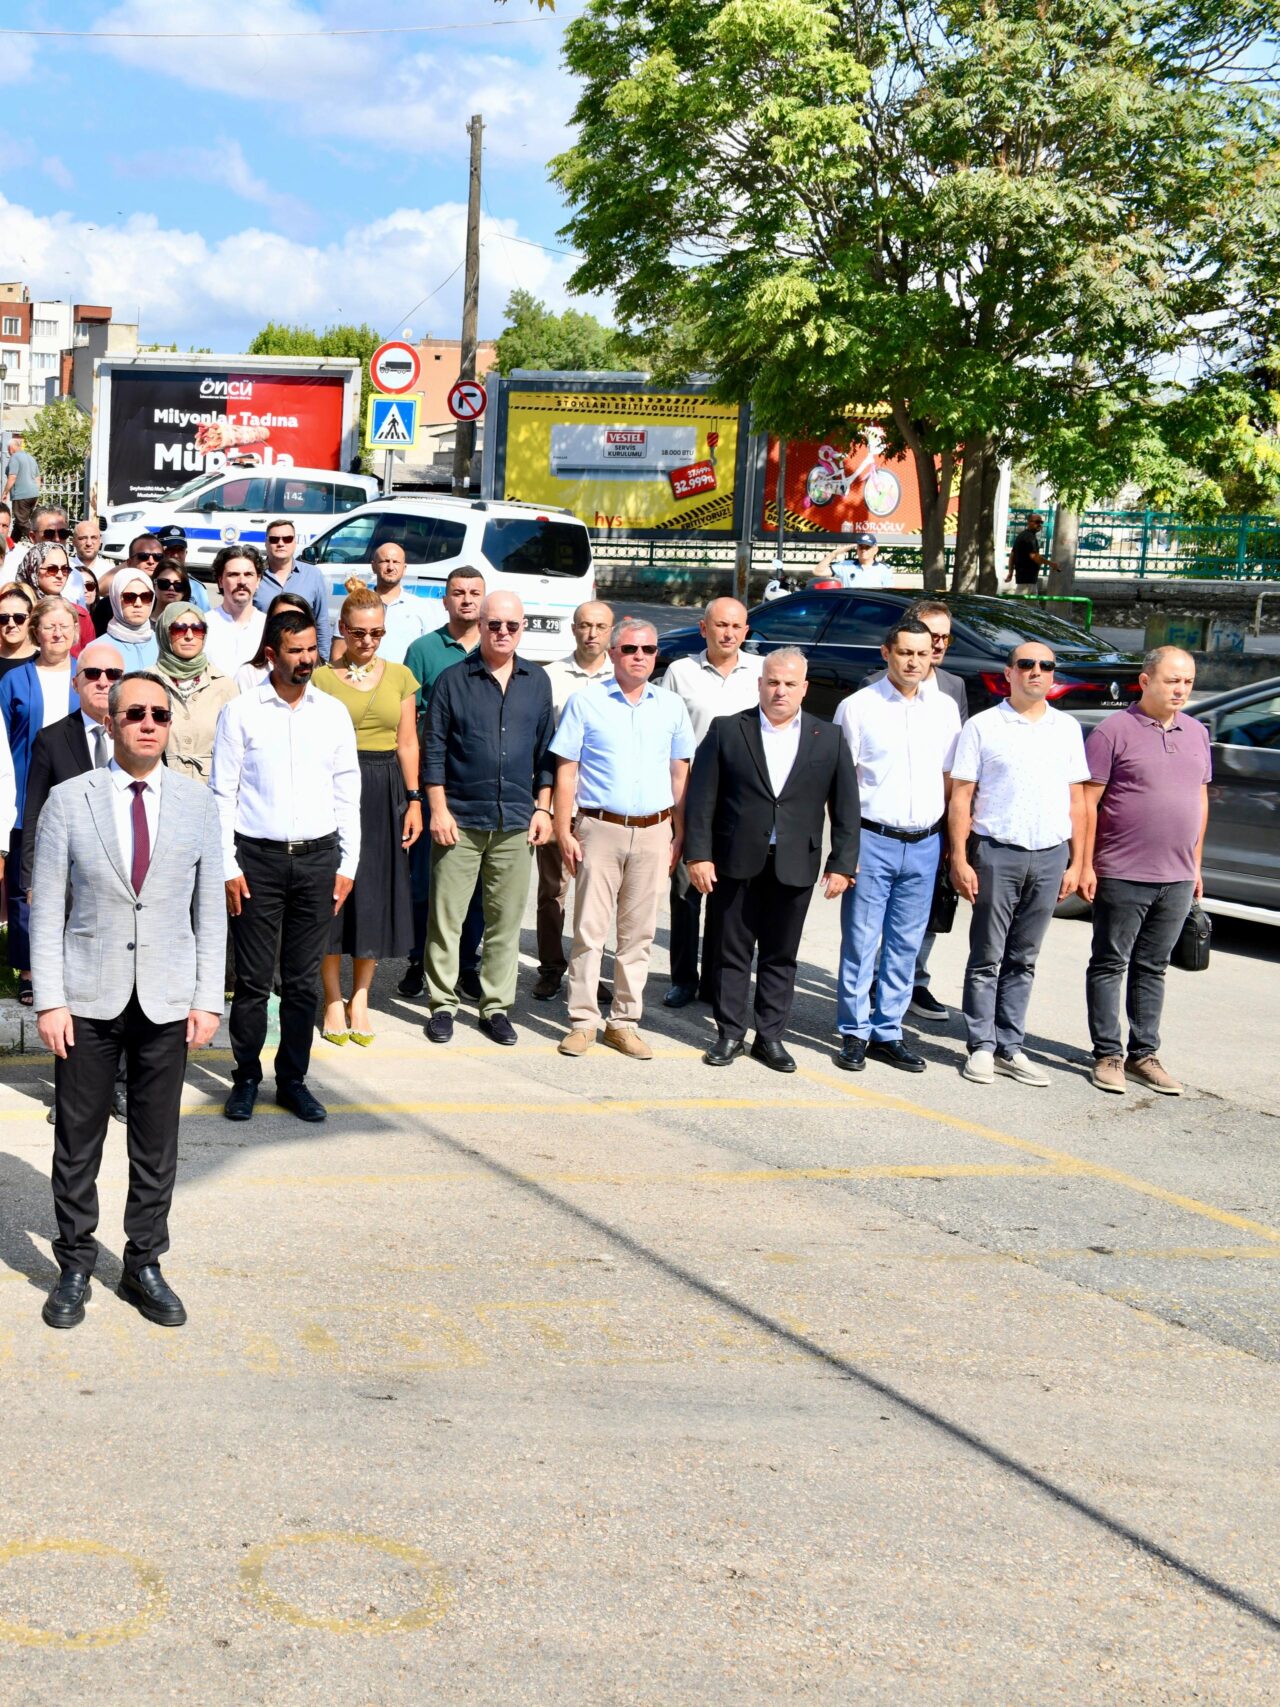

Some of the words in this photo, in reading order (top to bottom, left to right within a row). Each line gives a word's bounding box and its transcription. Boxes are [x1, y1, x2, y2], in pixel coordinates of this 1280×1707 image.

[556, 400, 610, 409] STOKLARI
[615, 402, 696, 414] ERİTİYORUZ!!!
[154, 408, 237, 427] Milyonlar
[239, 411, 299, 428] Tadına
[608, 432, 643, 443] VESTEL
[594, 511, 623, 528] hys
[532, 619, 542, 629] SK
[546, 620, 560, 630] 279
